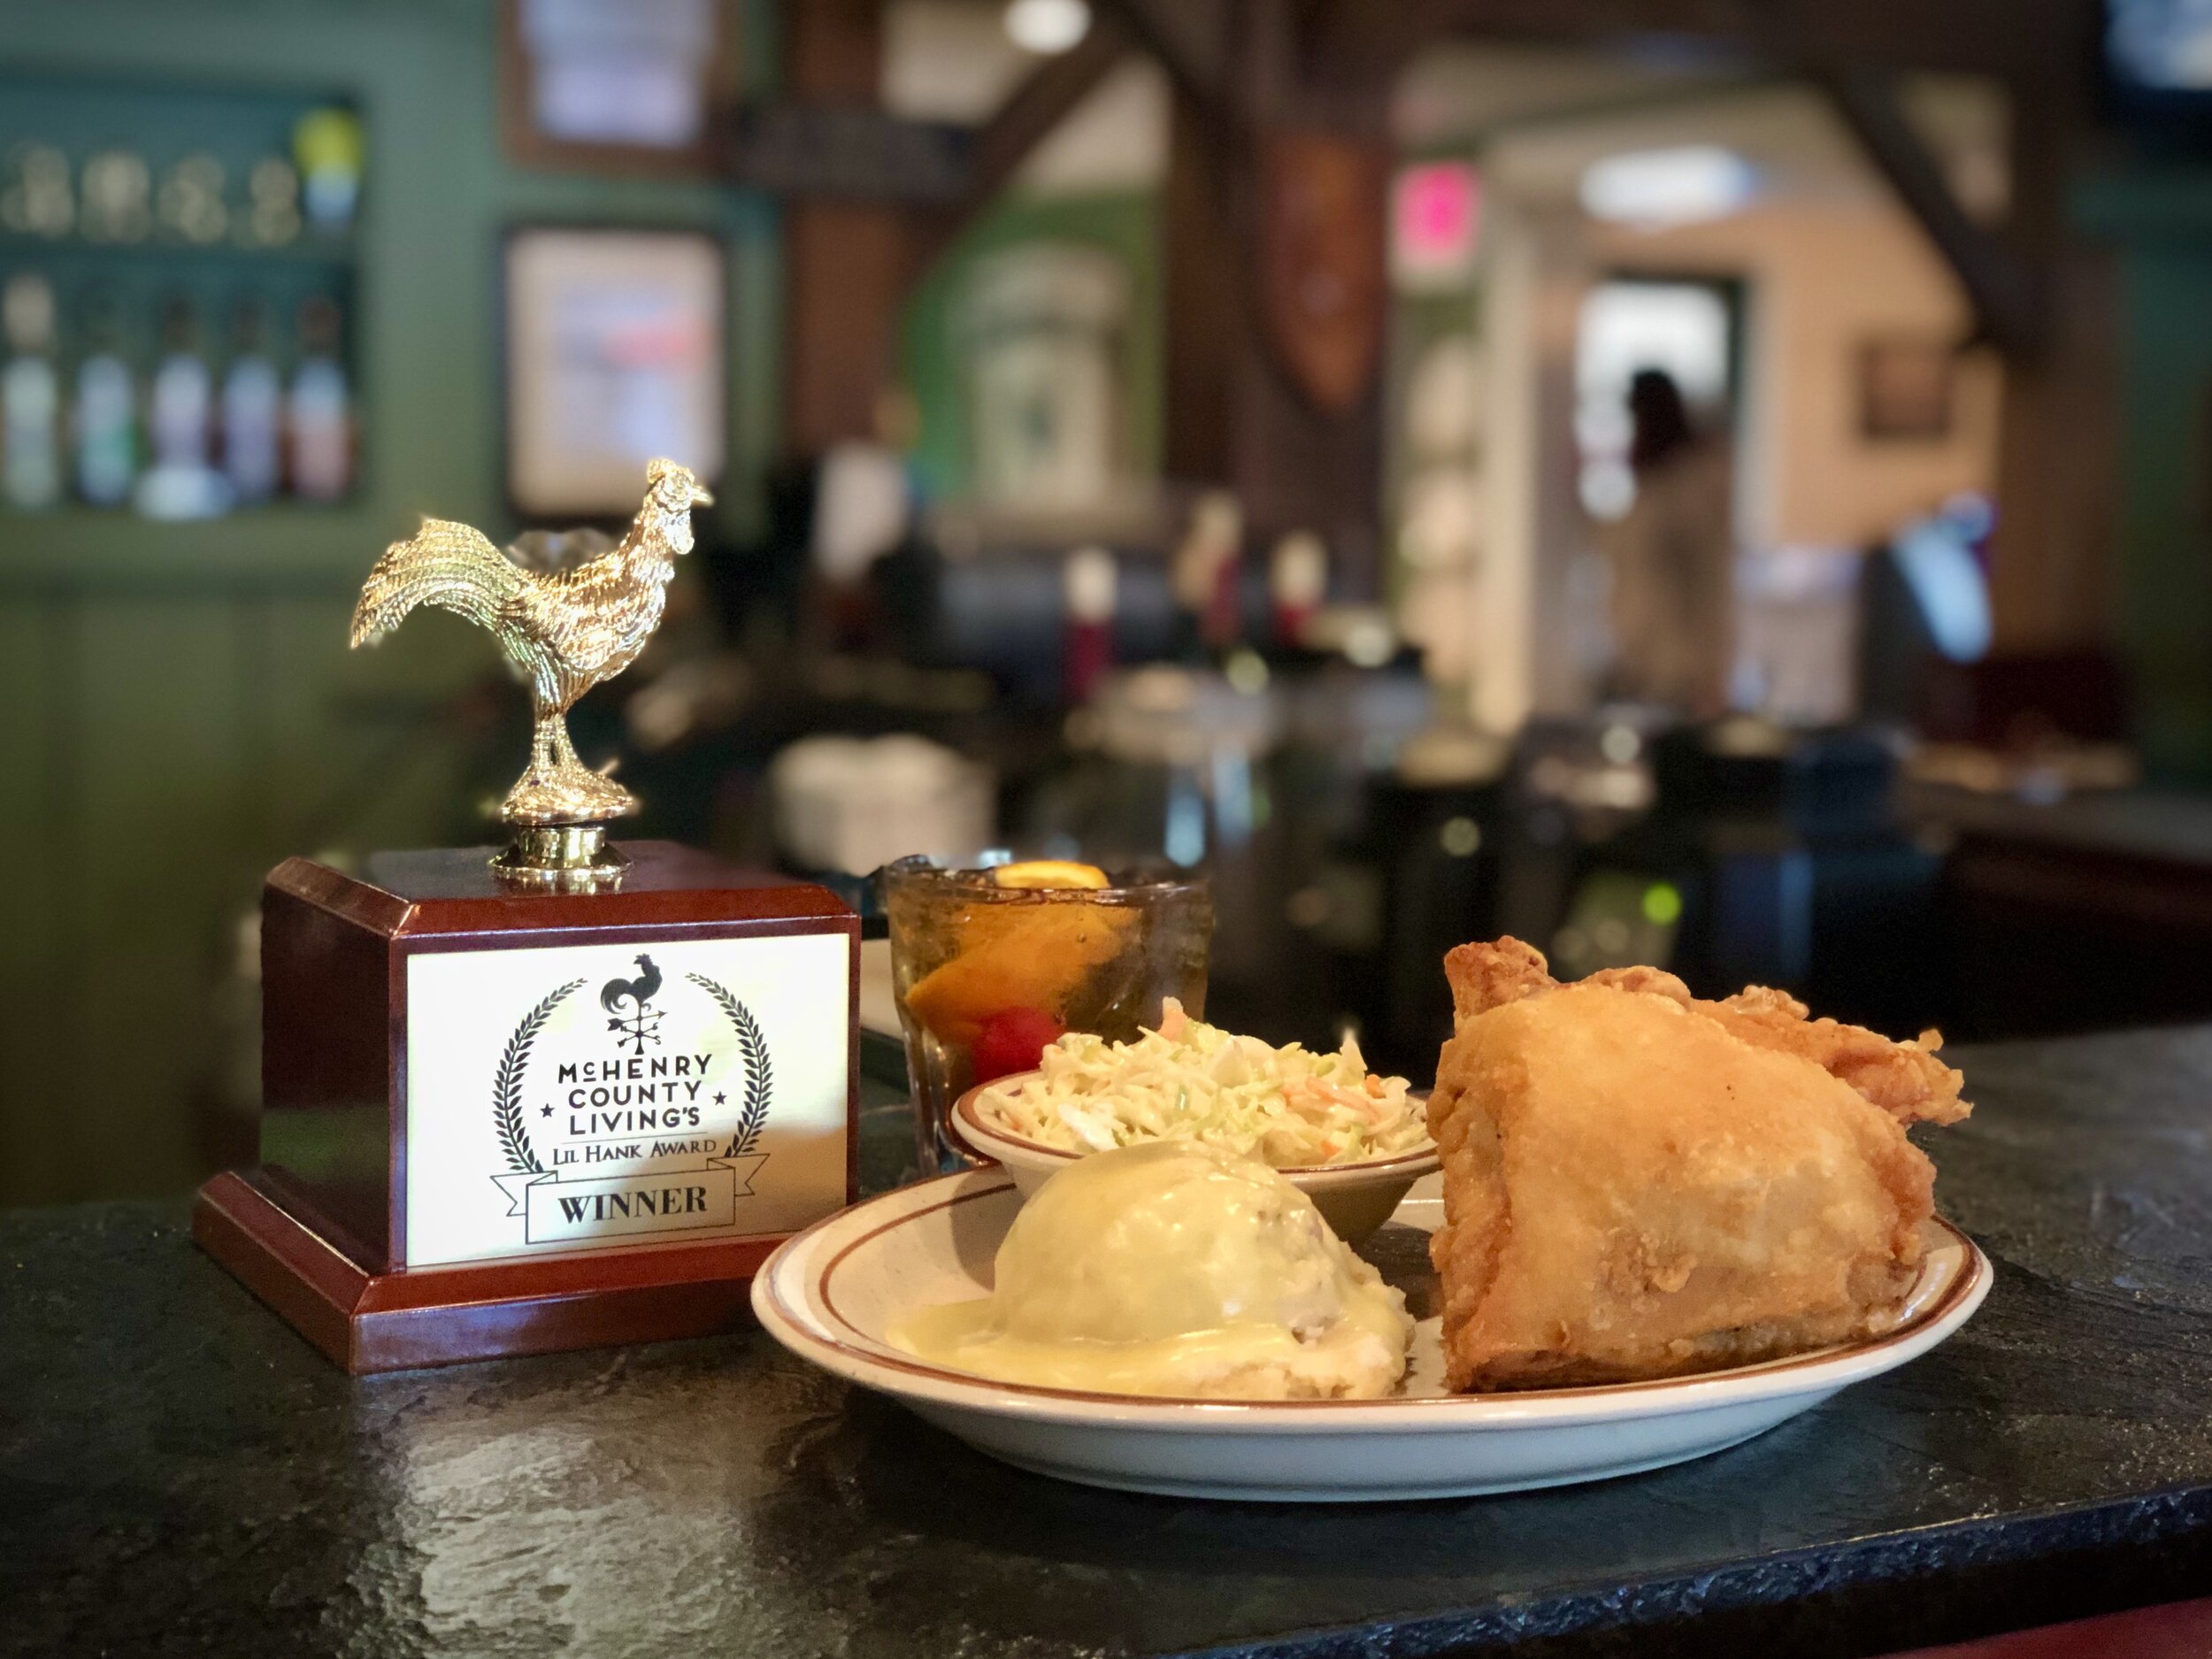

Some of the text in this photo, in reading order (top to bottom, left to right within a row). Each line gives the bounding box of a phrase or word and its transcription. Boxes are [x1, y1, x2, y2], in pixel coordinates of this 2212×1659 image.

[558, 1054, 712, 1084] McHENRY
[568, 1079, 702, 1109] COUNTY
[570, 1107, 700, 1135] LIVING'S
[585, 1144, 642, 1163] HANK
[649, 1140, 717, 1158] AWARD
[557, 1186, 708, 1224] WINNER
